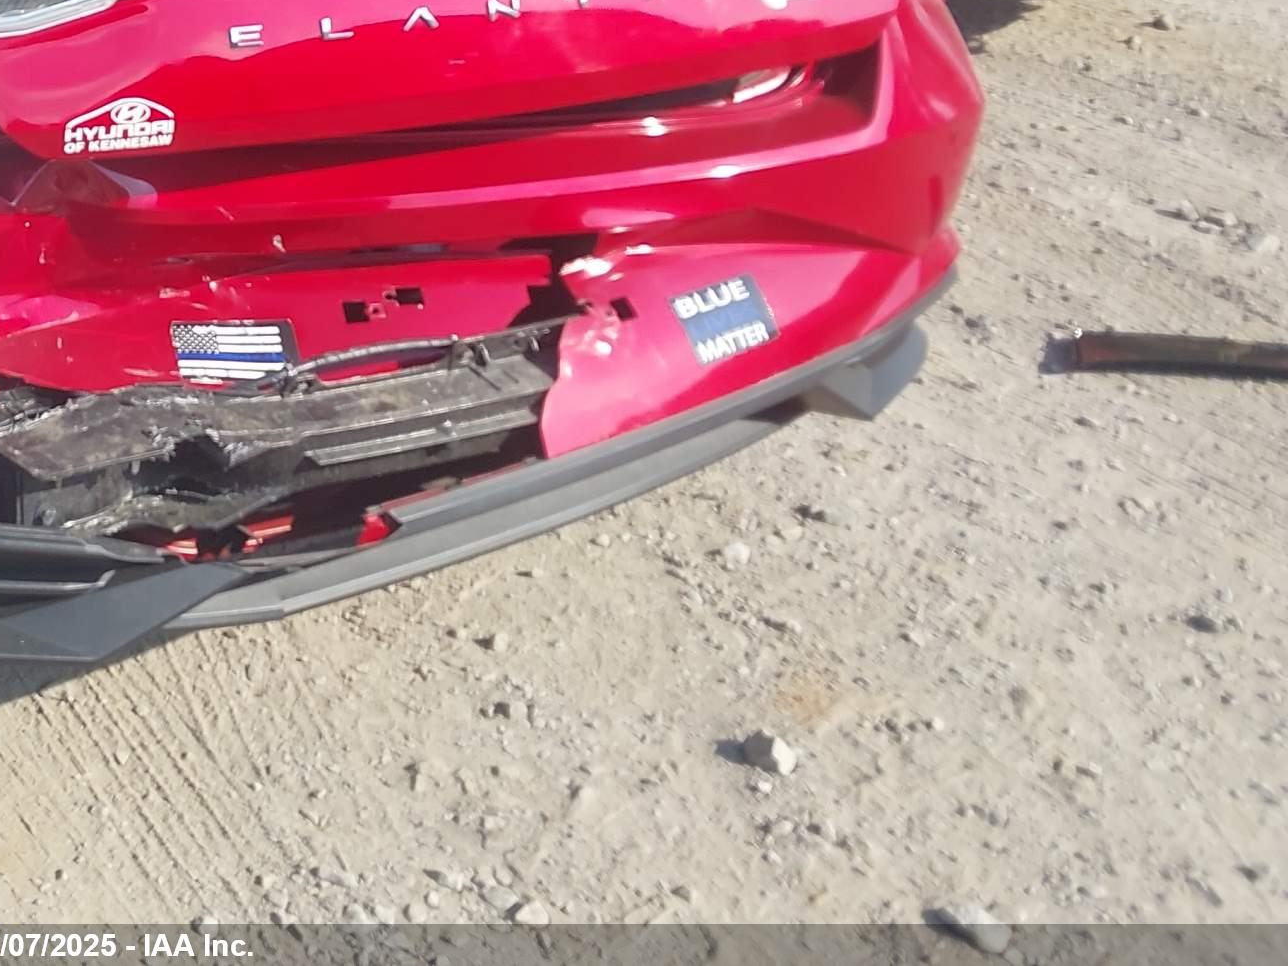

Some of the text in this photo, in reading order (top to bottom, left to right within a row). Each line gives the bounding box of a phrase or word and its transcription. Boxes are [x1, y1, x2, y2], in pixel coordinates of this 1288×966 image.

[63, 134, 173, 154] OF KENNESAW
[64, 119, 175, 142] HYUNDAI
[673, 279, 750, 319] BLUE
[696, 320, 770, 364] MATTER
